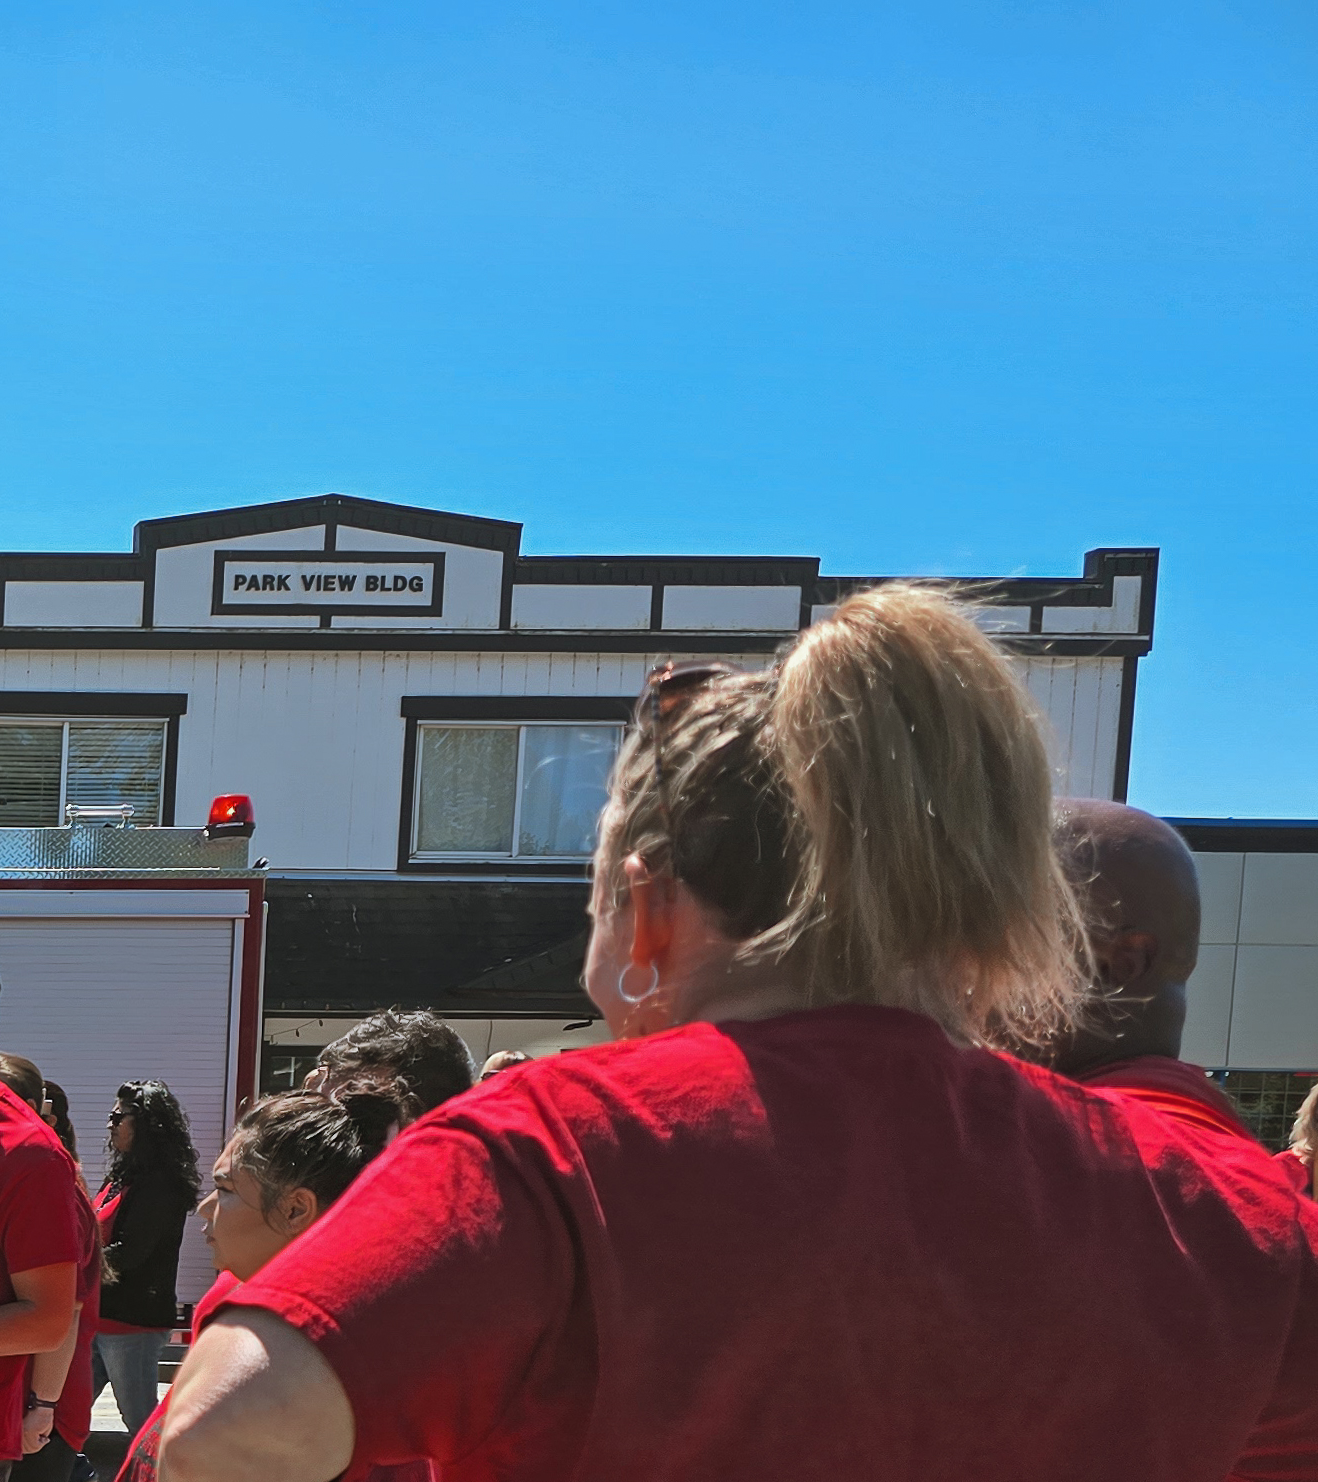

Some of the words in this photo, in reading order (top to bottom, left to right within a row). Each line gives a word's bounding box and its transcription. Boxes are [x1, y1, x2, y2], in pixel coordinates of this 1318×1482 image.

[233, 574, 291, 592] PARK
[301, 575, 357, 592] VIEW
[365, 576, 424, 592] BLDG
